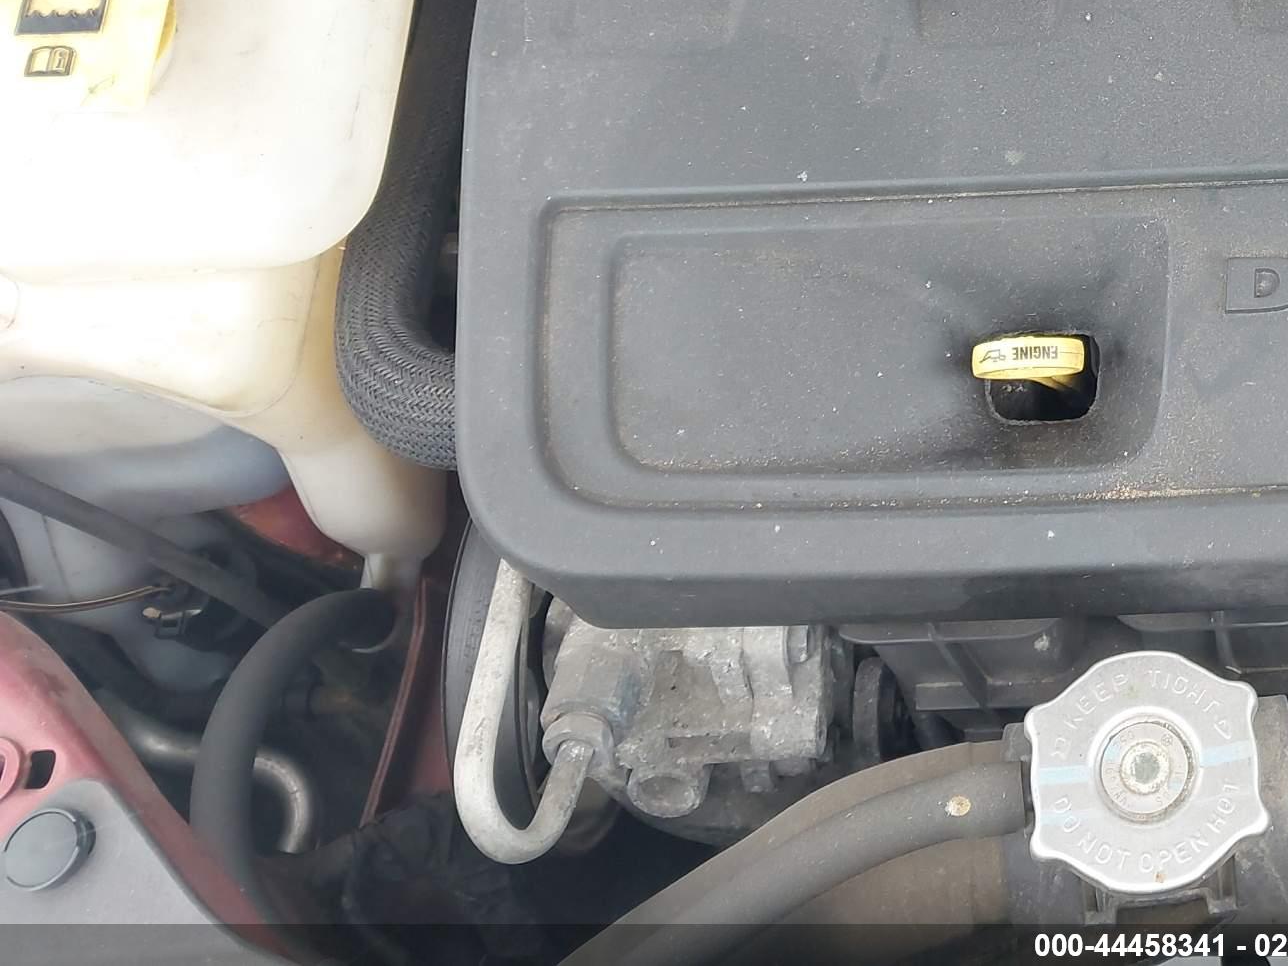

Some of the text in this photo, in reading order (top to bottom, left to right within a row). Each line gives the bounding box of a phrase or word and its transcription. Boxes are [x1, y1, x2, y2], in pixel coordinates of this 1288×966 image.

[1012, 346, 1058, 360] ENGINE
[1064, 669, 1220, 730] KEEP TIGHT
[1053, 784, 1240, 873] DO NOT OPEN HOT
